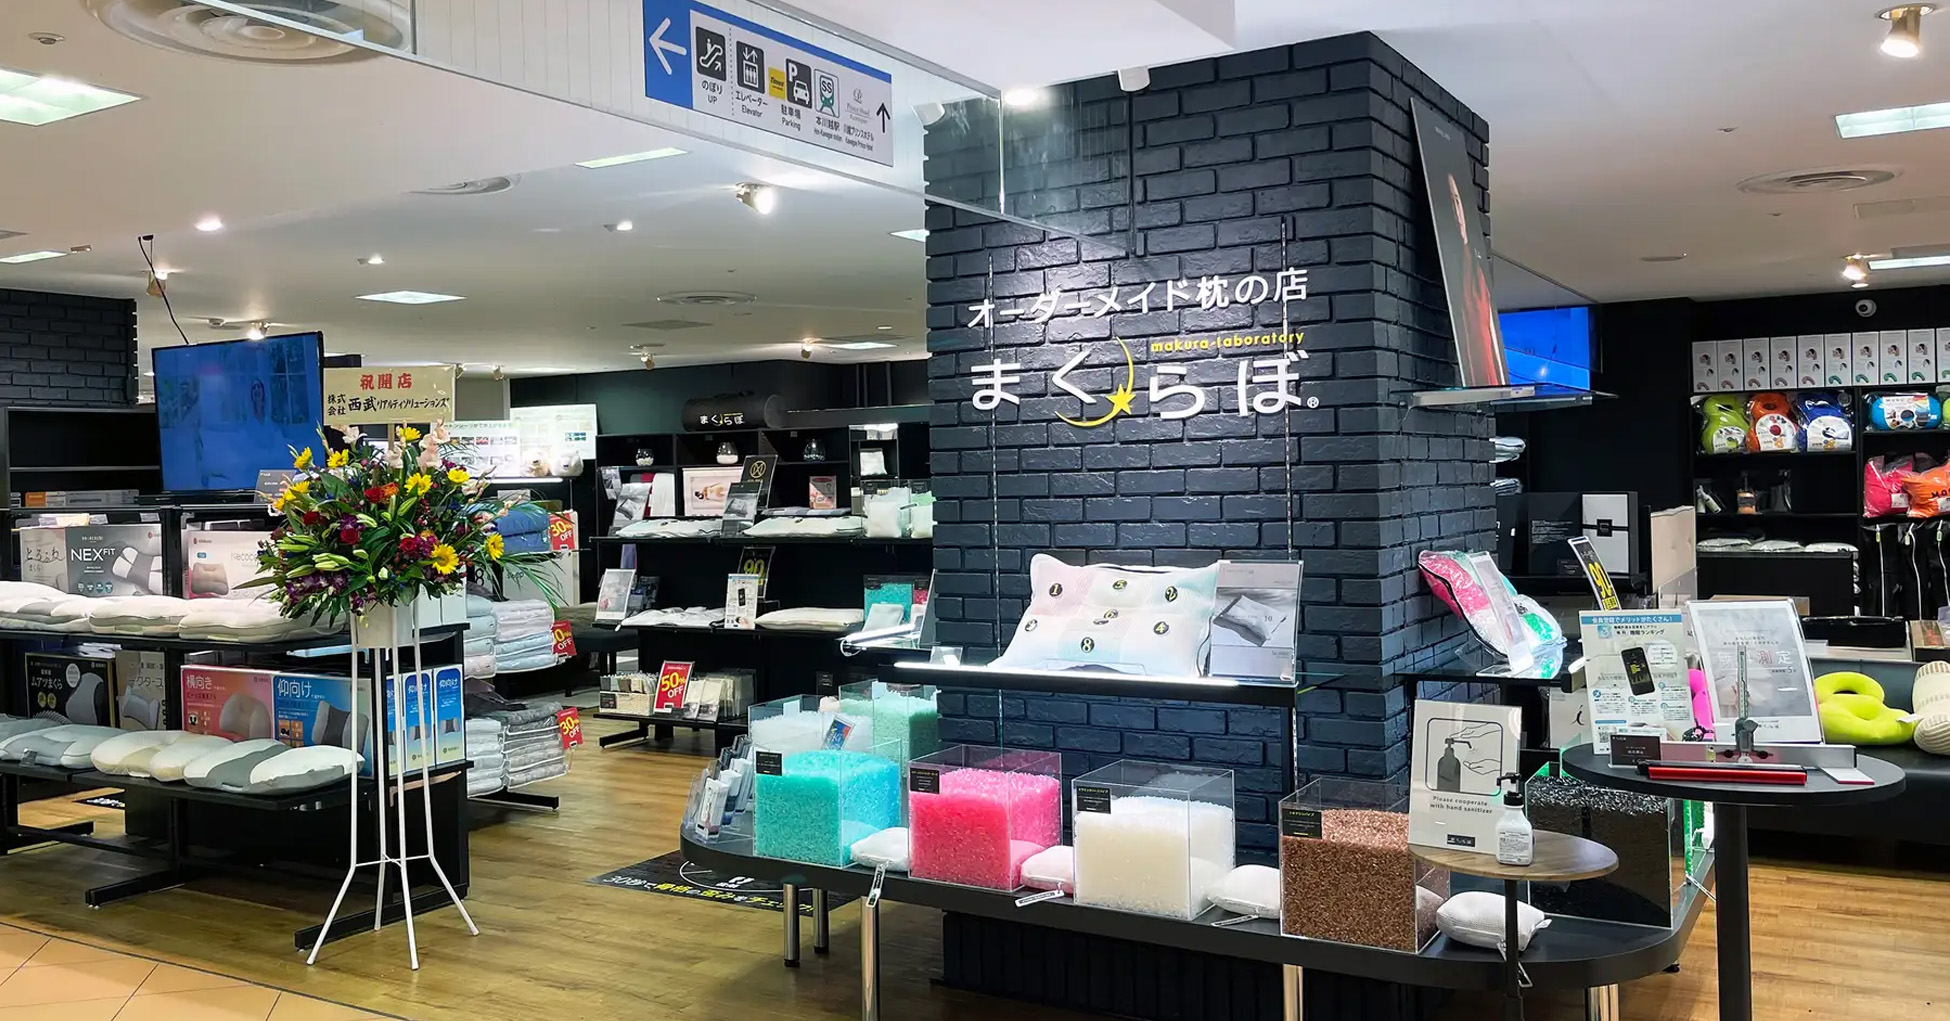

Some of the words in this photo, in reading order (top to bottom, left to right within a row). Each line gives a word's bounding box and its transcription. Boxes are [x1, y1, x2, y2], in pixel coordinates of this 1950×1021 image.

[701, 80, 723, 95] のぼり
[707, 94, 718, 104] UP
[735, 90, 768, 107] エレベーター
[741, 104, 763, 118] Elevator
[781, 104, 801, 120] 駐車場
[781, 116, 801, 132] Parking
[967, 266, 1309, 329] オーダーメイド枕の店
[1150, 330, 1305, 353] makura-laboratory
[360, 373, 413, 390] 祝開店
[560, 529, 573, 541] OFF
[557, 637, 573, 650] OFF
[186, 674, 213, 690] 横向き
[278, 678, 312, 698] 仰向け
[661, 671, 687, 692] 50%
[667, 684, 684, 698] OFF
[569, 724, 580, 738] OFF
[1432, 795, 1453, 803] Please
[1454, 798, 1488, 806] cooperate
[1463, 806, 1493, 814] sanitizer
